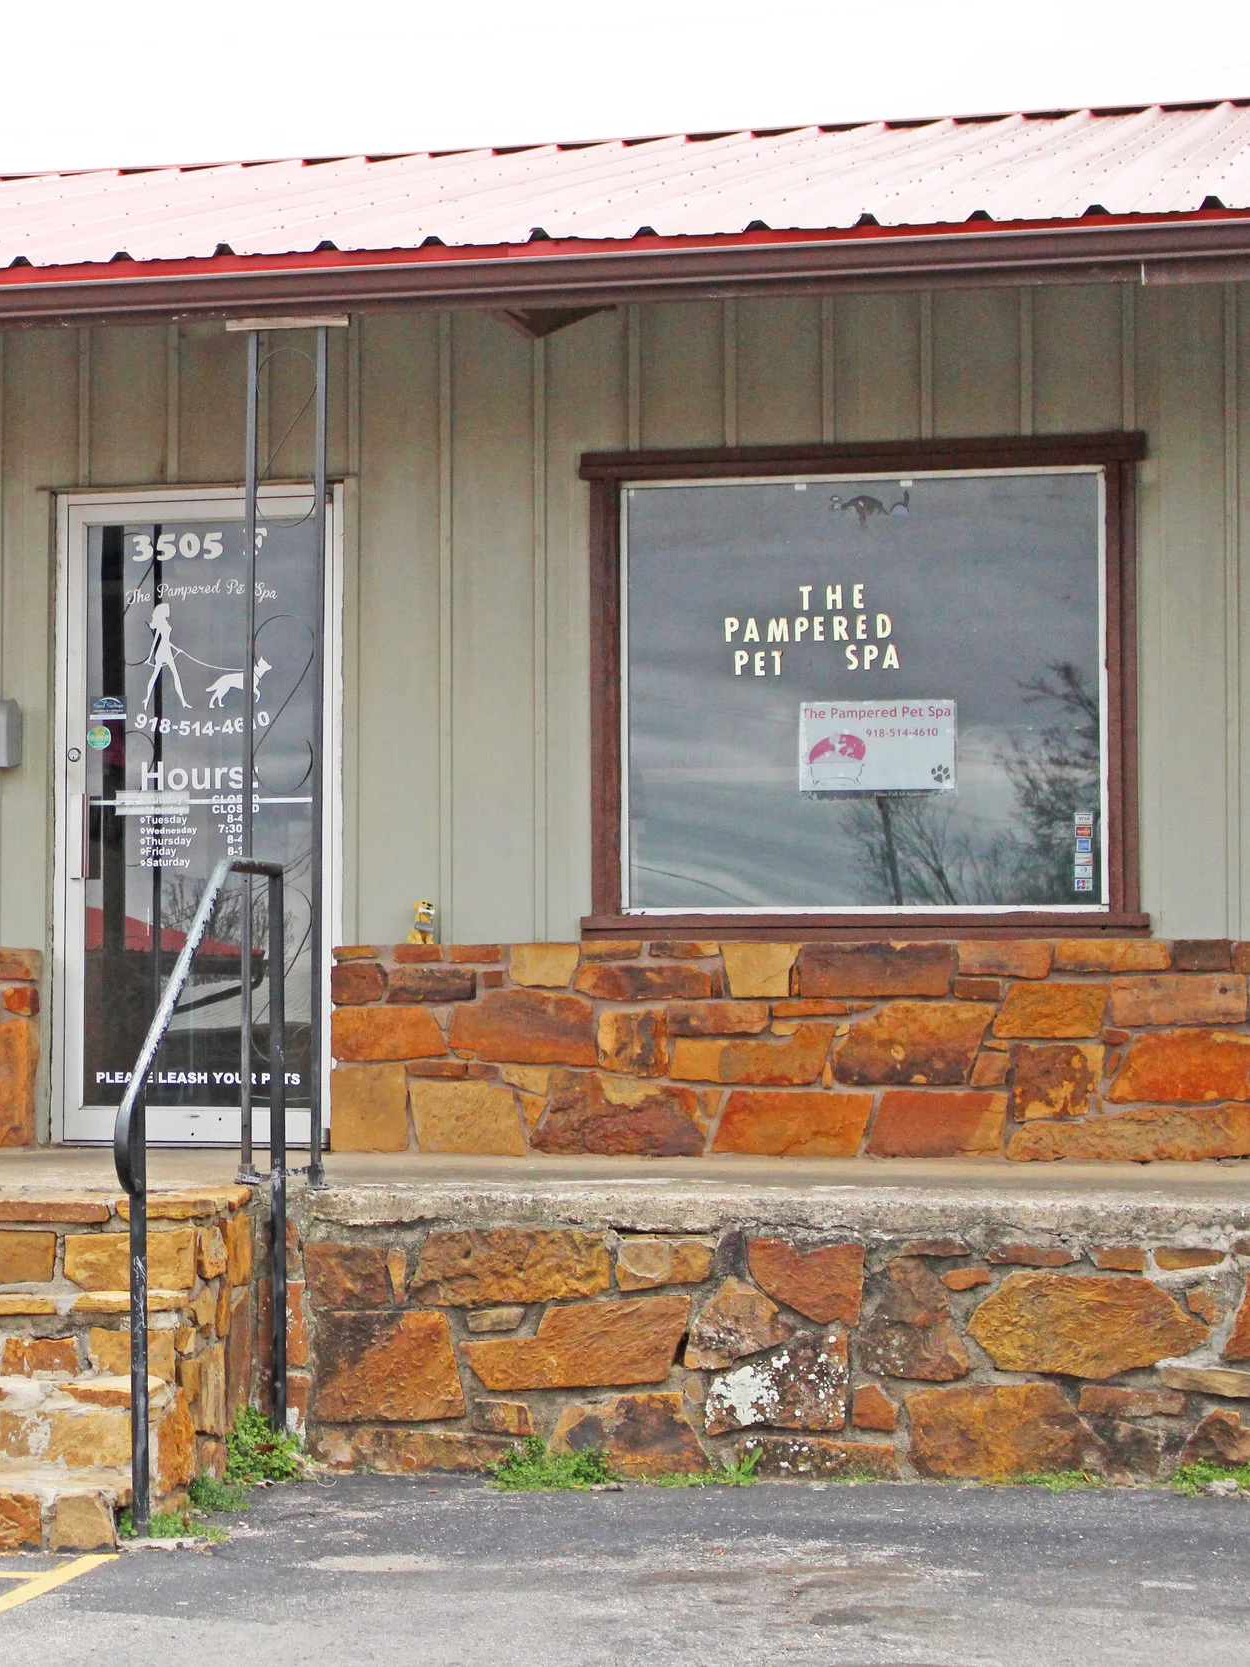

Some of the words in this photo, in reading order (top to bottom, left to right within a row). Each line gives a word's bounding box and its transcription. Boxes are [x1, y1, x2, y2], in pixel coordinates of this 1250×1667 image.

[132, 532, 224, 562] 3505
[125, 590, 151, 606] The
[156, 579, 221, 600] Pampered
[226, 579, 245, 596] Pe
[254, 582, 278, 604] Spa
[799, 583, 865, 611] THE
[724, 613, 893, 643] PAMPERED
[734, 650, 784, 677] PET
[845, 643, 900, 671] SPA
[803, 707, 827, 719] The
[830, 706, 898, 721] Pampered
[902, 706, 924, 718] Pet
[928, 706, 952, 720] Spa
[866, 727, 939, 738] 918-514-4610
[212, 794, 260, 804] CLOSD
[212, 804, 260, 814] CLOSD
[146, 815, 188, 826] Tuesday
[146, 826, 198, 836] Wednesday
[146, 836, 192, 847] Thursday
[146, 846, 177, 857] Friday
[146, 858, 191, 868] Saturday
[96, 1071, 154, 1085] PLEAE
[158, 1071, 208, 1085] LEASH
[261, 1072, 301, 1086] PTS
